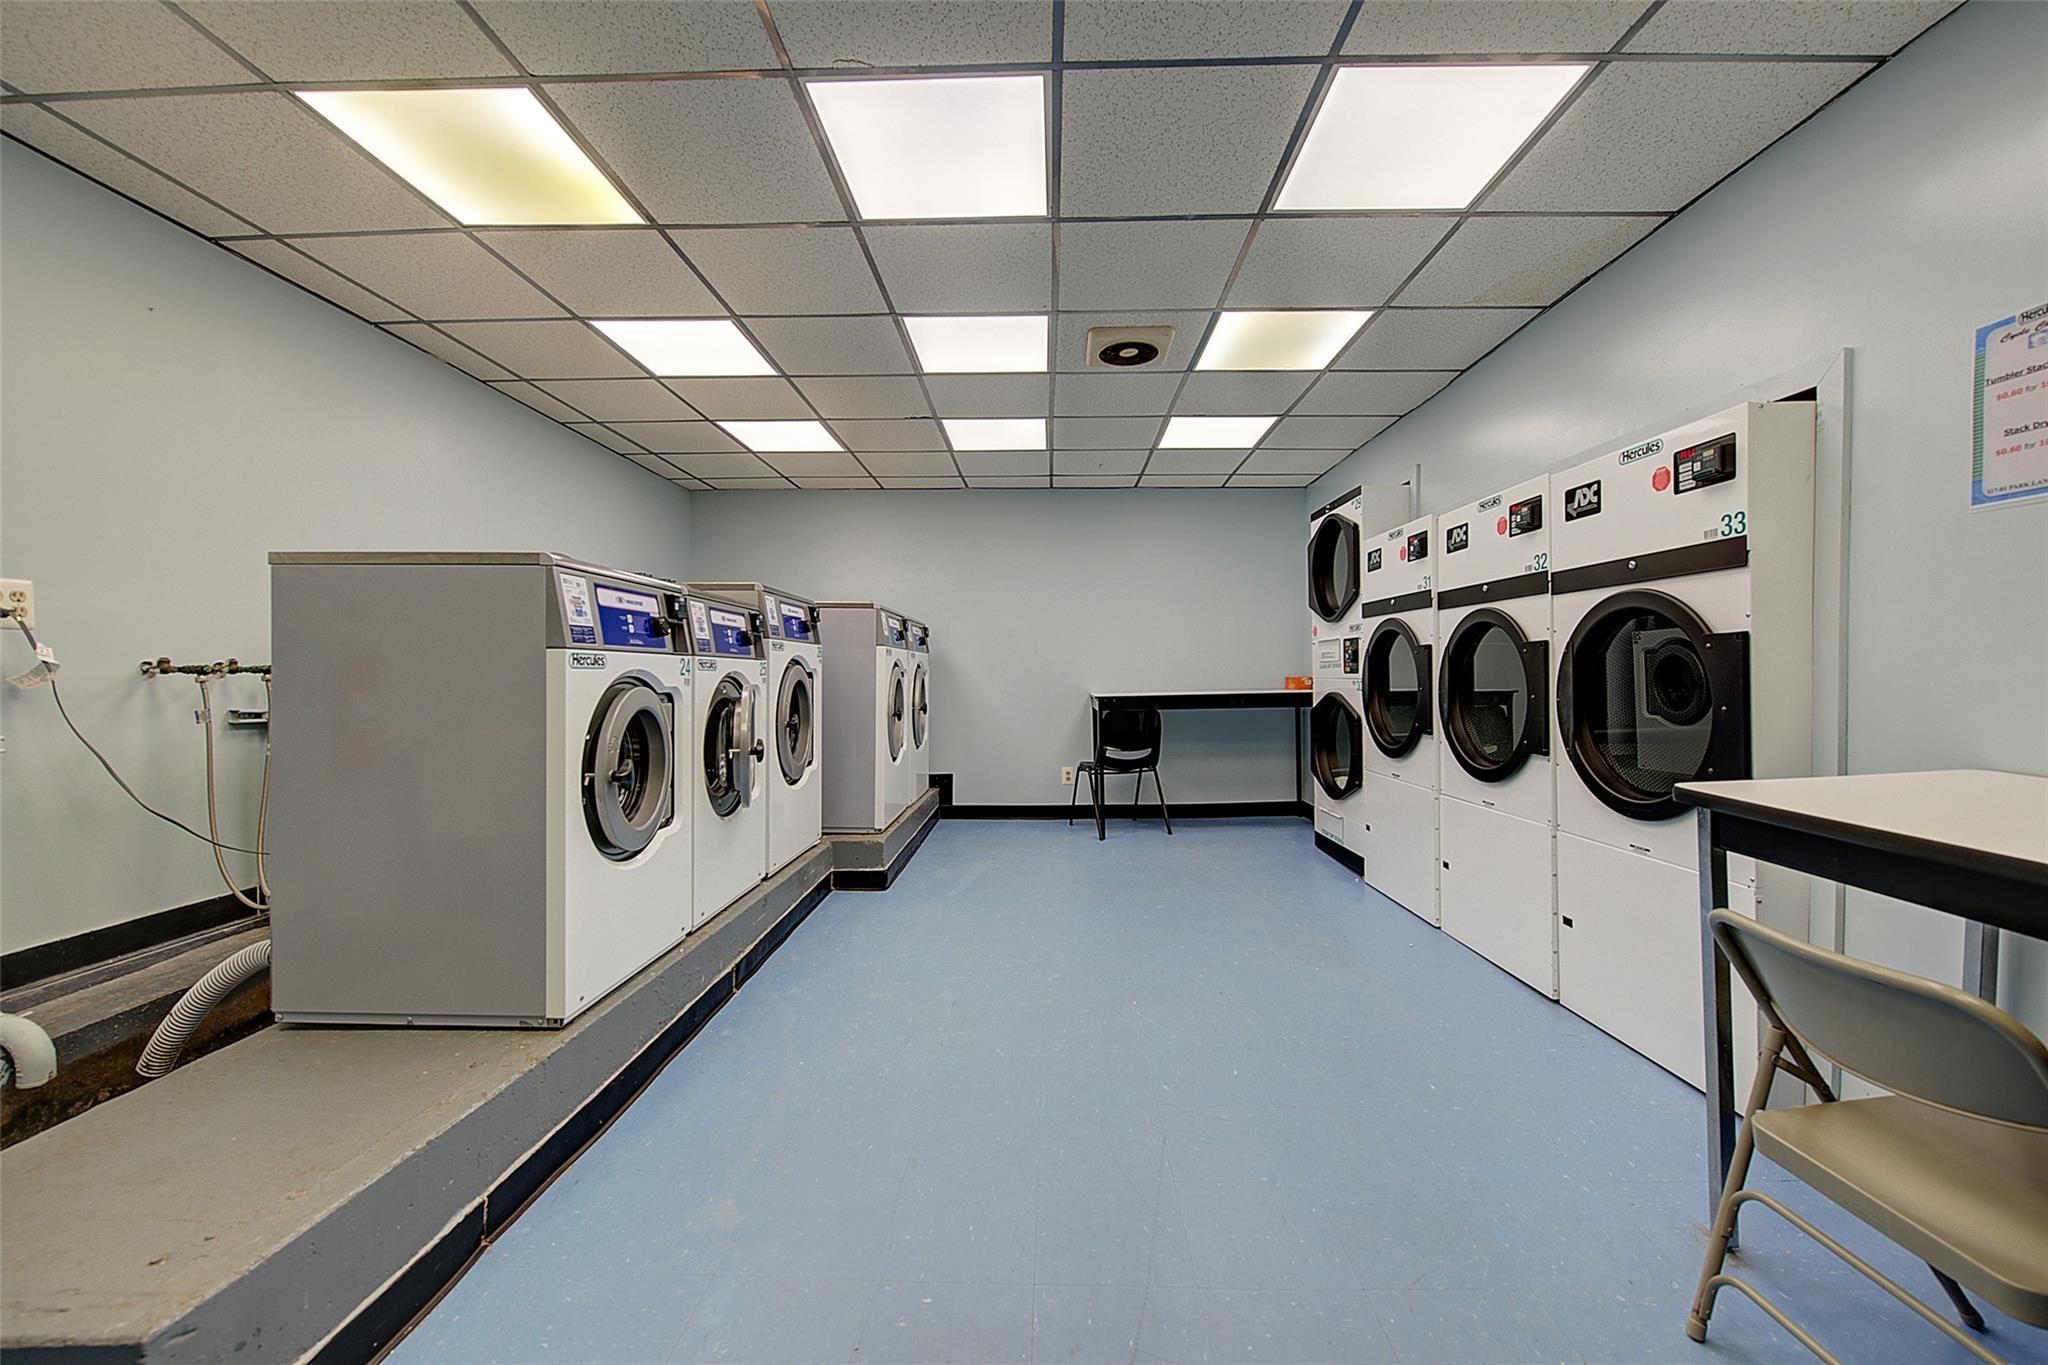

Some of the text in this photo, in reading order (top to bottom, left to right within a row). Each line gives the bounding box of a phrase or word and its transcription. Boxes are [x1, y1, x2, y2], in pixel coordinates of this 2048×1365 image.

[1986, 368, 2023, 386] Tumbler
[1996, 387, 2023, 401] $0.60
[2025, 383, 2038, 392] for
[2004, 424, 2030, 437] Stack
[1622, 441, 1660, 462] Hercules
[1996, 444, 2022, 457] $0.60
[2025, 442, 2037, 450] for
[1573, 483, 1599, 509] ADC
[1721, 511, 1746, 537] 33
[1534, 553, 1548, 571] 32
[1423, 576, 1432, 589] 31
[571, 653, 605, 667] Hercules
[680, 658, 691, 676] 24
